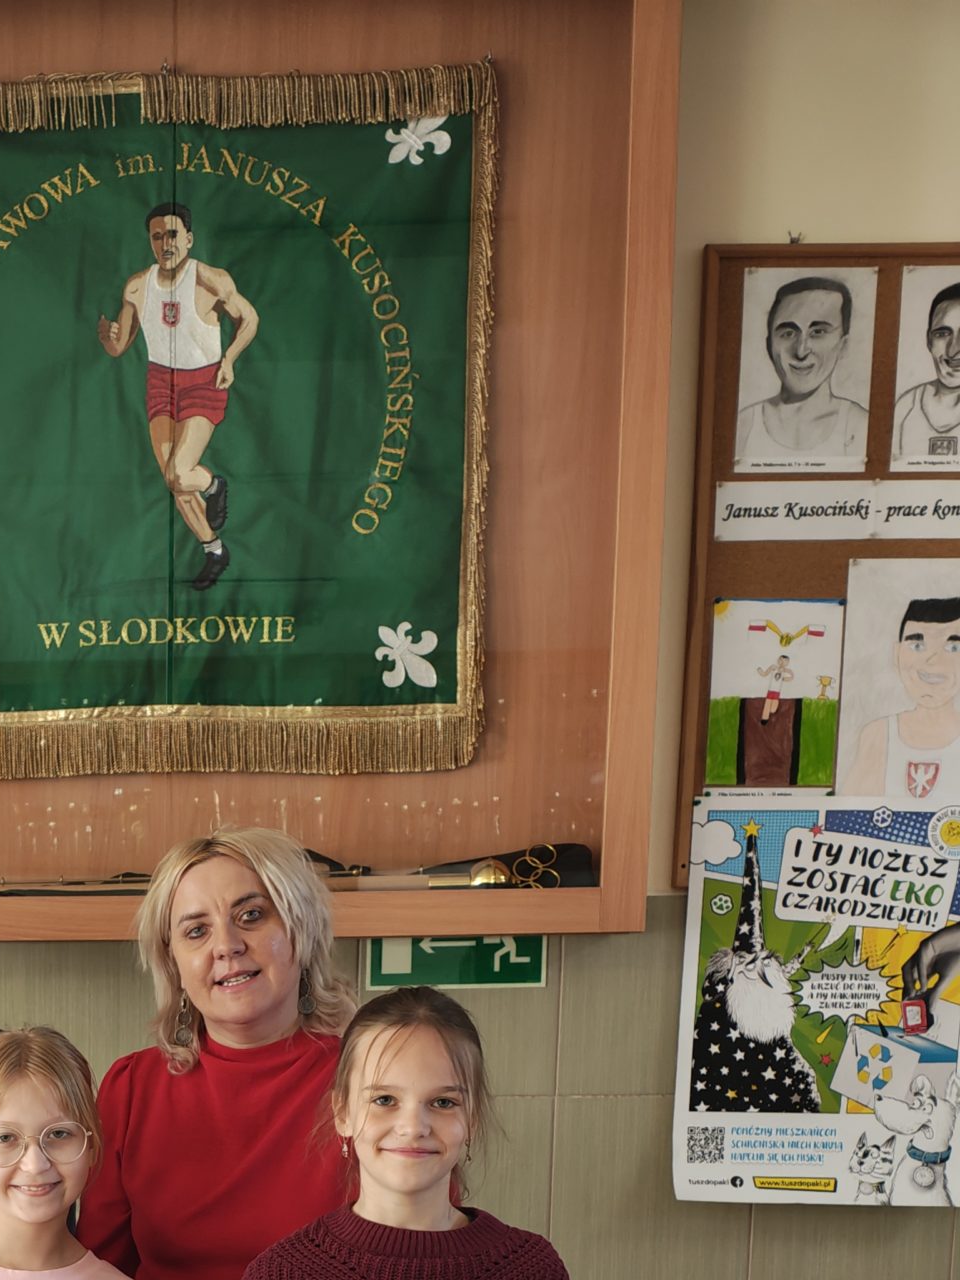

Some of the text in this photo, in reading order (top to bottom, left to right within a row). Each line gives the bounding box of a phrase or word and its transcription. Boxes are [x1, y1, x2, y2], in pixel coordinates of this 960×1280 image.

[115, 152, 164, 178] im.
[175, 142, 328, 226] JANUSZA
[332, 223, 420, 535] KUSOCIŃSKIEGO
[722, 503, 779, 521] Janusz
[784, 499, 871, 520] Kusociński
[884, 504, 928, 522] prace
[37, 615, 296, 649] W SŁODKOWIE
[794, 839, 948, 878] I TY MOŻESZ
[786, 866, 944, 907] ZOSTAĆ EKO
[781, 891, 939, 928] CZARODZIEJEM!
[821, 973, 870, 981] PUSTY TUSZ
[688, 1178, 831, 1188] tuszdopaki www.tuszdopaki.pl
